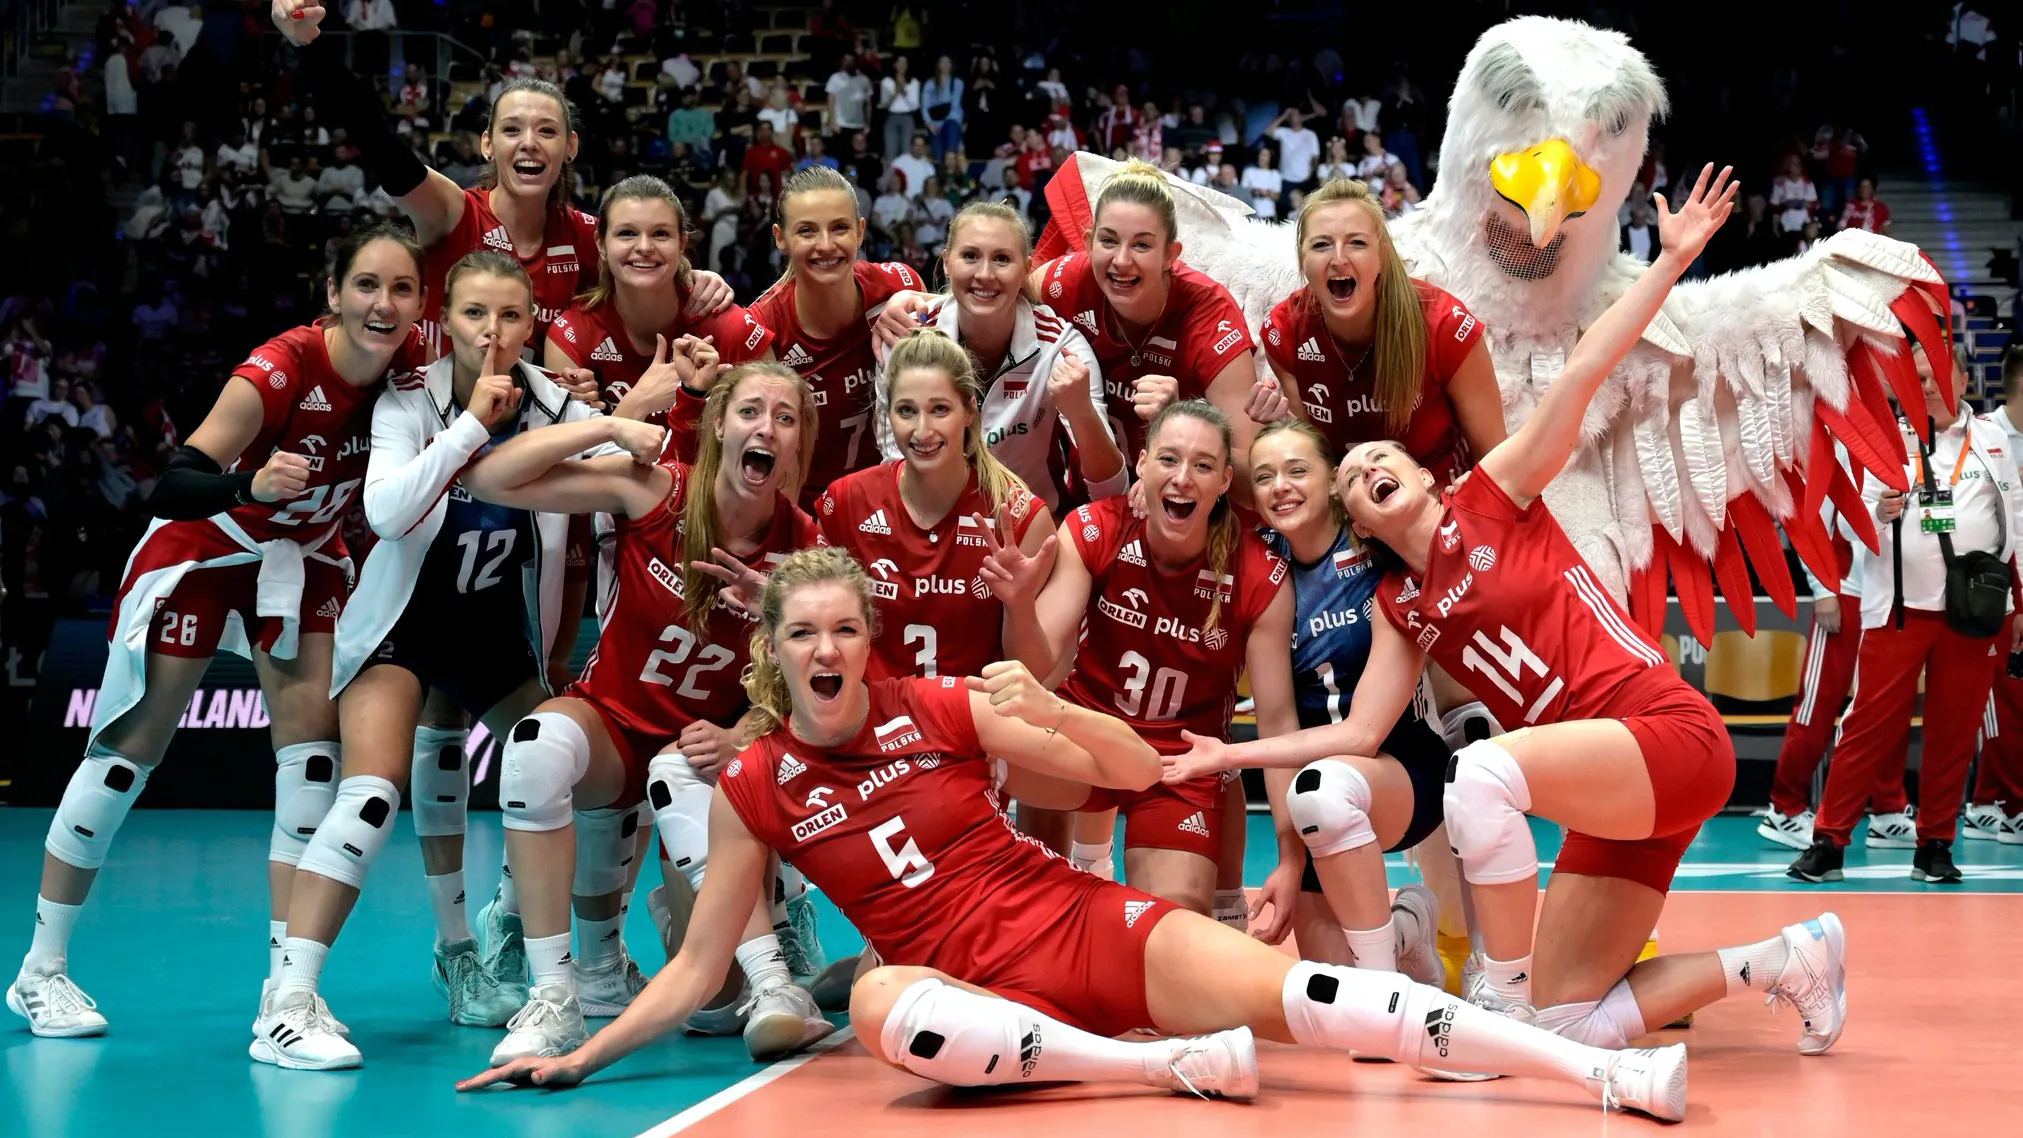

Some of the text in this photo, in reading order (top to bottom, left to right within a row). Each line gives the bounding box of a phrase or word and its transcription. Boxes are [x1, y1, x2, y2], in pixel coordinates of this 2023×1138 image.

[547, 263, 580, 275] POLSKA
[1072, 315, 1100, 336] adidas
[1216, 331, 1242, 352] ORLEN
[591, 351, 623, 363] adidas
[844, 368, 876, 393] plu
[1105, 378, 1136, 402] plu
[300, 401, 332, 412] adidas
[1304, 402, 1329, 421] RLEN
[1346, 394, 1391, 417] plu
[840, 411, 869, 470] 7
[986, 422, 1028, 448] plus
[336, 436, 372, 461] plu
[1960, 470, 1980, 481] lus
[859, 523, 892, 535] adidas
[956, 536, 989, 547] POLSK
[456, 528, 517, 594] 12
[1116, 551, 1147, 567] adidas
[1337, 560, 1373, 580] POLSKA
[915, 575, 966, 597] plus
[1194, 588, 1231, 604] POLKA
[1436, 570, 1474, 617] plus
[1099, 600, 1144, 625] ORLEN
[1310, 607, 1358, 638] plus
[160, 611, 198, 646] 26
[1154, 616, 1201, 643] plus
[639, 624, 736, 700] 22
[904, 624, 937, 679] 3
[1462, 625, 1550, 708] 14
[1114, 650, 1189, 721] 30
[1315, 662, 1343, 724] 1
[881, 732, 923, 753] POLSKA
[777, 762, 808, 786] adidas
[857, 758, 911, 802] plus
[796, 808, 844, 839] ORLEN
[1177, 821, 1210, 838] adidas
[868, 815, 936, 889] 5
[1126, 901, 1156, 928] adidas
[1439, 1003, 1459, 1058] adidas
[1022, 1023, 1042, 1078] adidas
